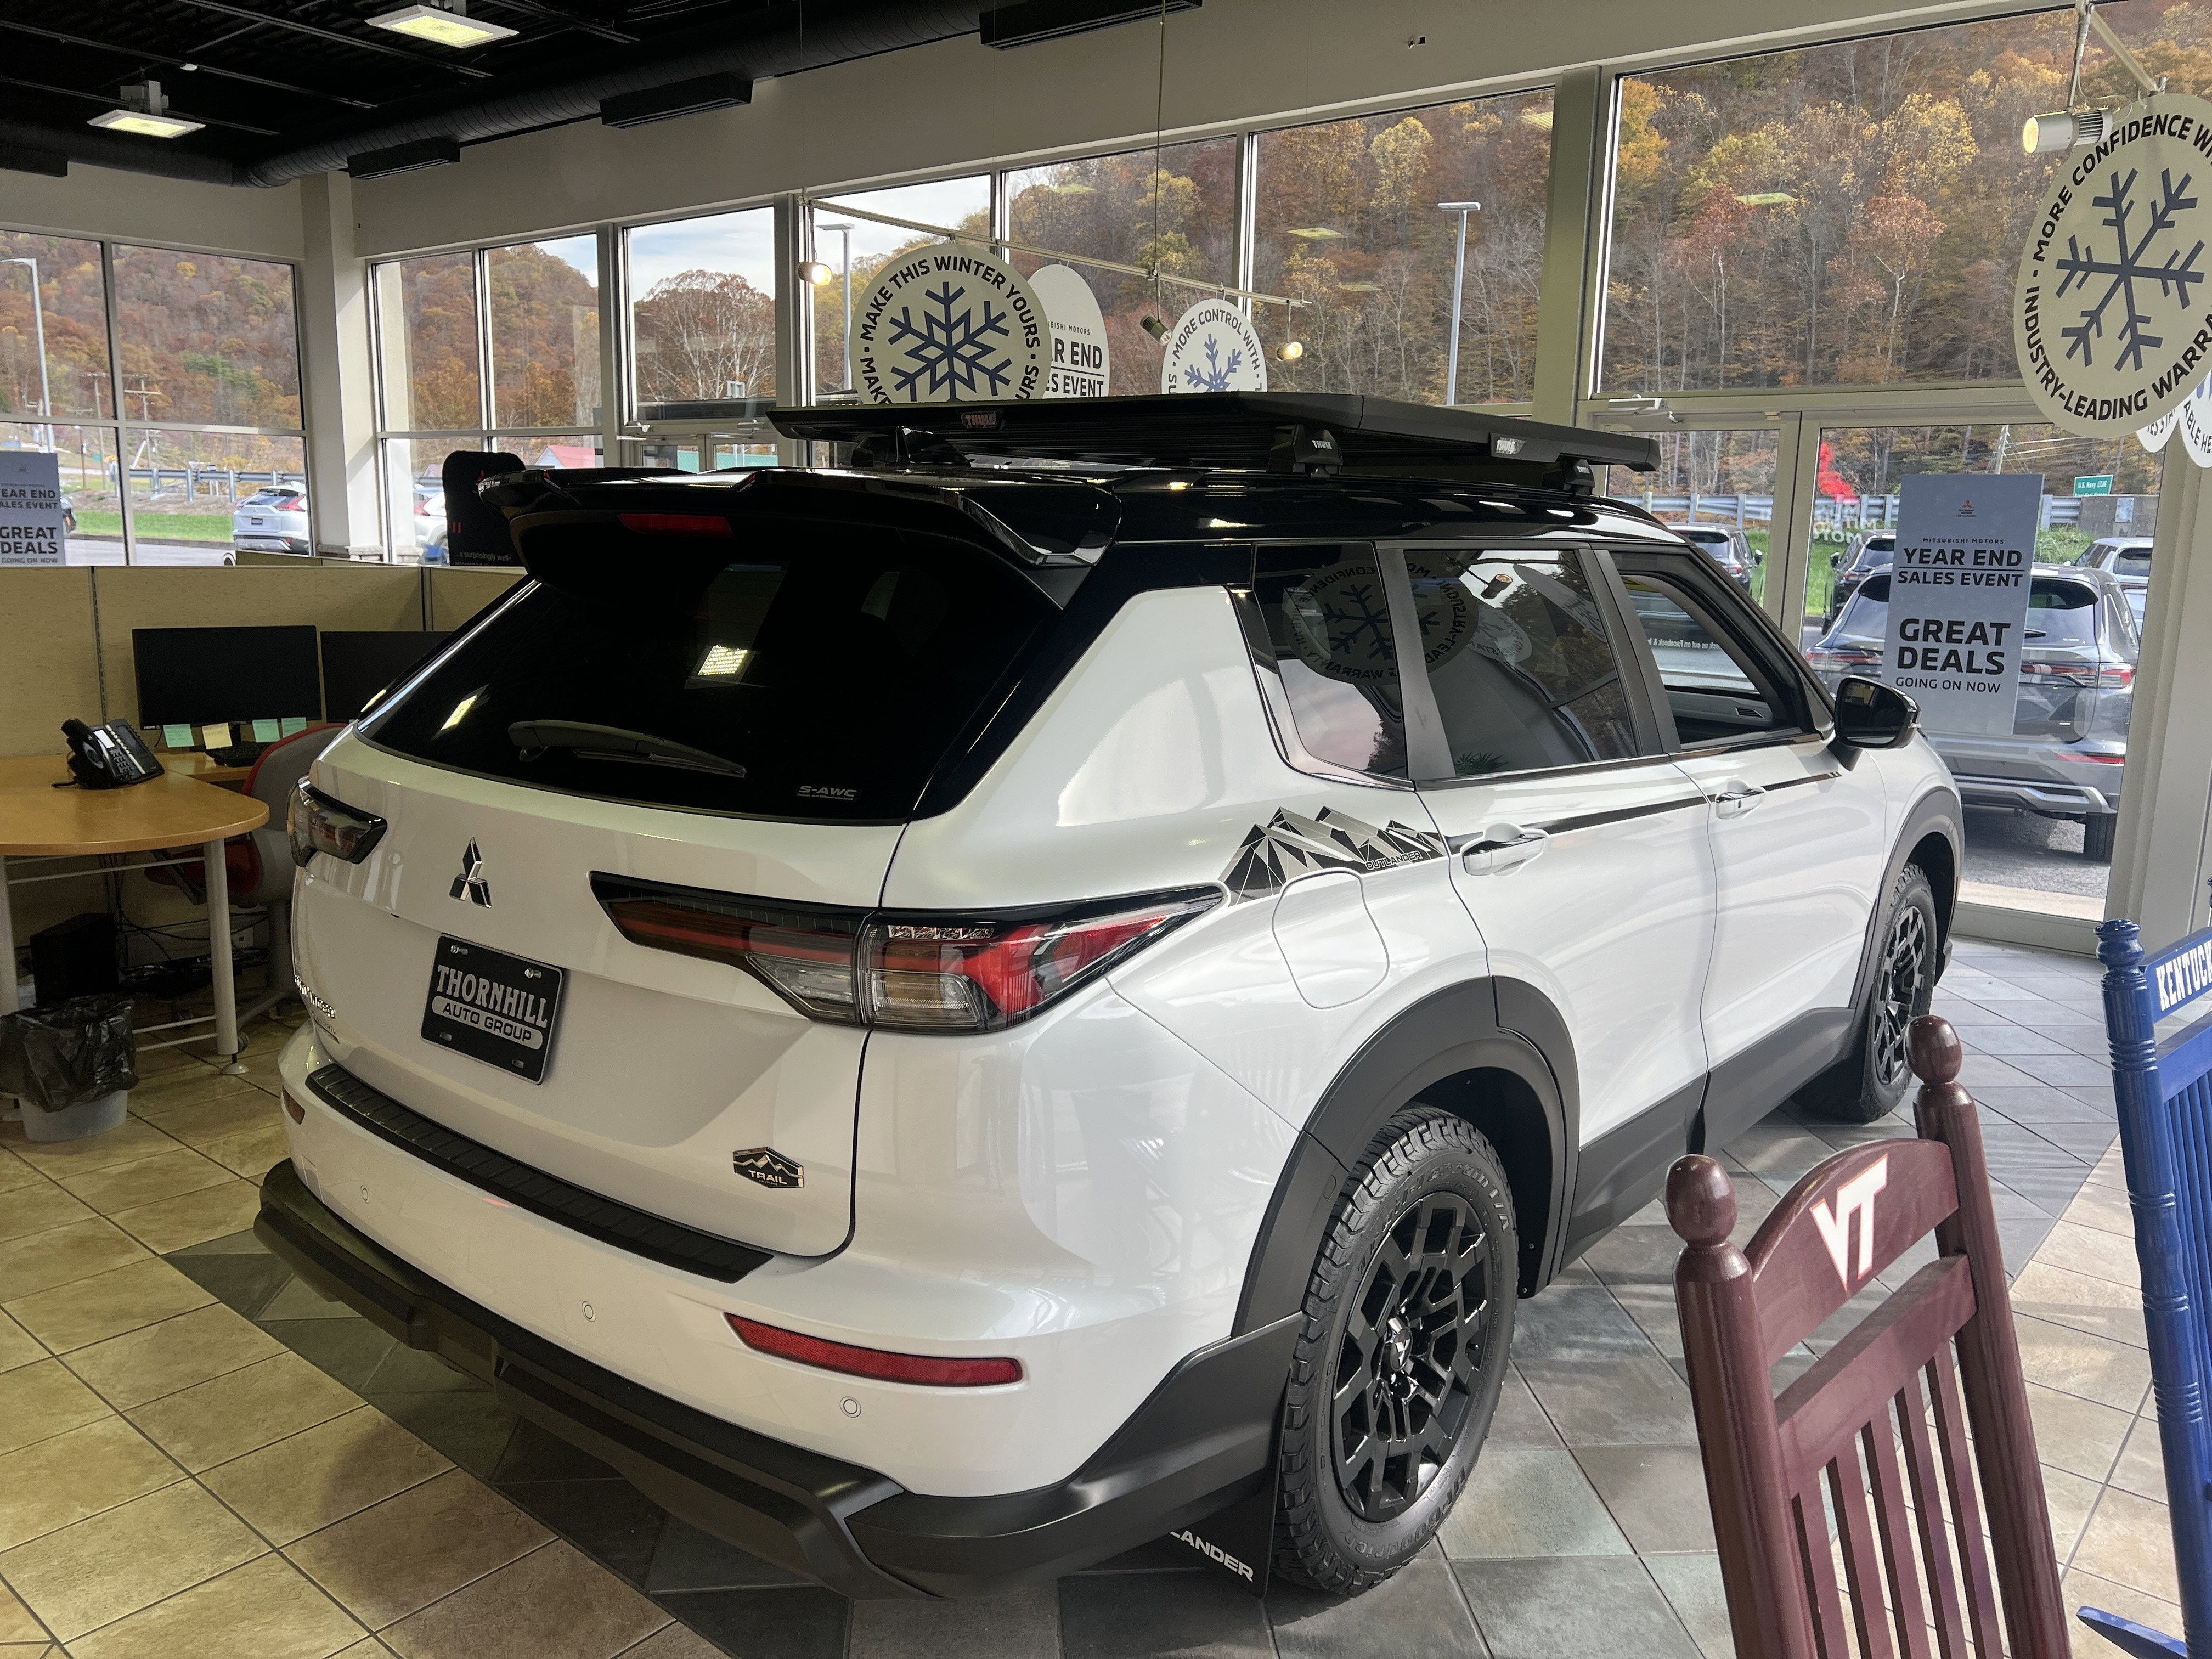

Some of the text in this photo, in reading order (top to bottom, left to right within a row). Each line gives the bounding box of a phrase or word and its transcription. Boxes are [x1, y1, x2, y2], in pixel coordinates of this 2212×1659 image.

[2033, 185, 2073, 262] MORE
[2072, 114, 2194, 186] CONFIDENCE
[860, 255, 1040, 348] MAKE THIS WINTER YOURS
[1068, 325, 1091, 336] MOTORS
[1172, 308, 1260, 370] MORE CONTROL WITH
[1070, 341, 1102, 369] END
[2024, 286, 2148, 421] INDUSTRY-LEADING
[1063, 374, 1104, 397] EVENT
[1312, 440, 1333, 449] THULE
[30, 489, 56, 499] END
[26, 501, 58, 510] EVENT
[0, 526, 57, 539] GREAT
[1, 541, 58, 555] DEALS
[1903, 548, 2023, 567] YEAR END
[1898, 570, 2024, 588] SALES EVENT
[1899, 618, 2011, 646] GREAT
[1897, 646, 2005, 675] DEALS
[1895, 676, 2001, 693] GOING ON NOW
[799, 785, 857, 797] S-AWC
[1365, 850, 1424, 871] OUTLANDER
[437, 964, 548, 1029] THORNHILL
[442, 1002, 532, 1042] AUTO GROUP
[748, 1170, 788, 1185] TRAIL
[1809, 1153, 1888, 1291] VT
